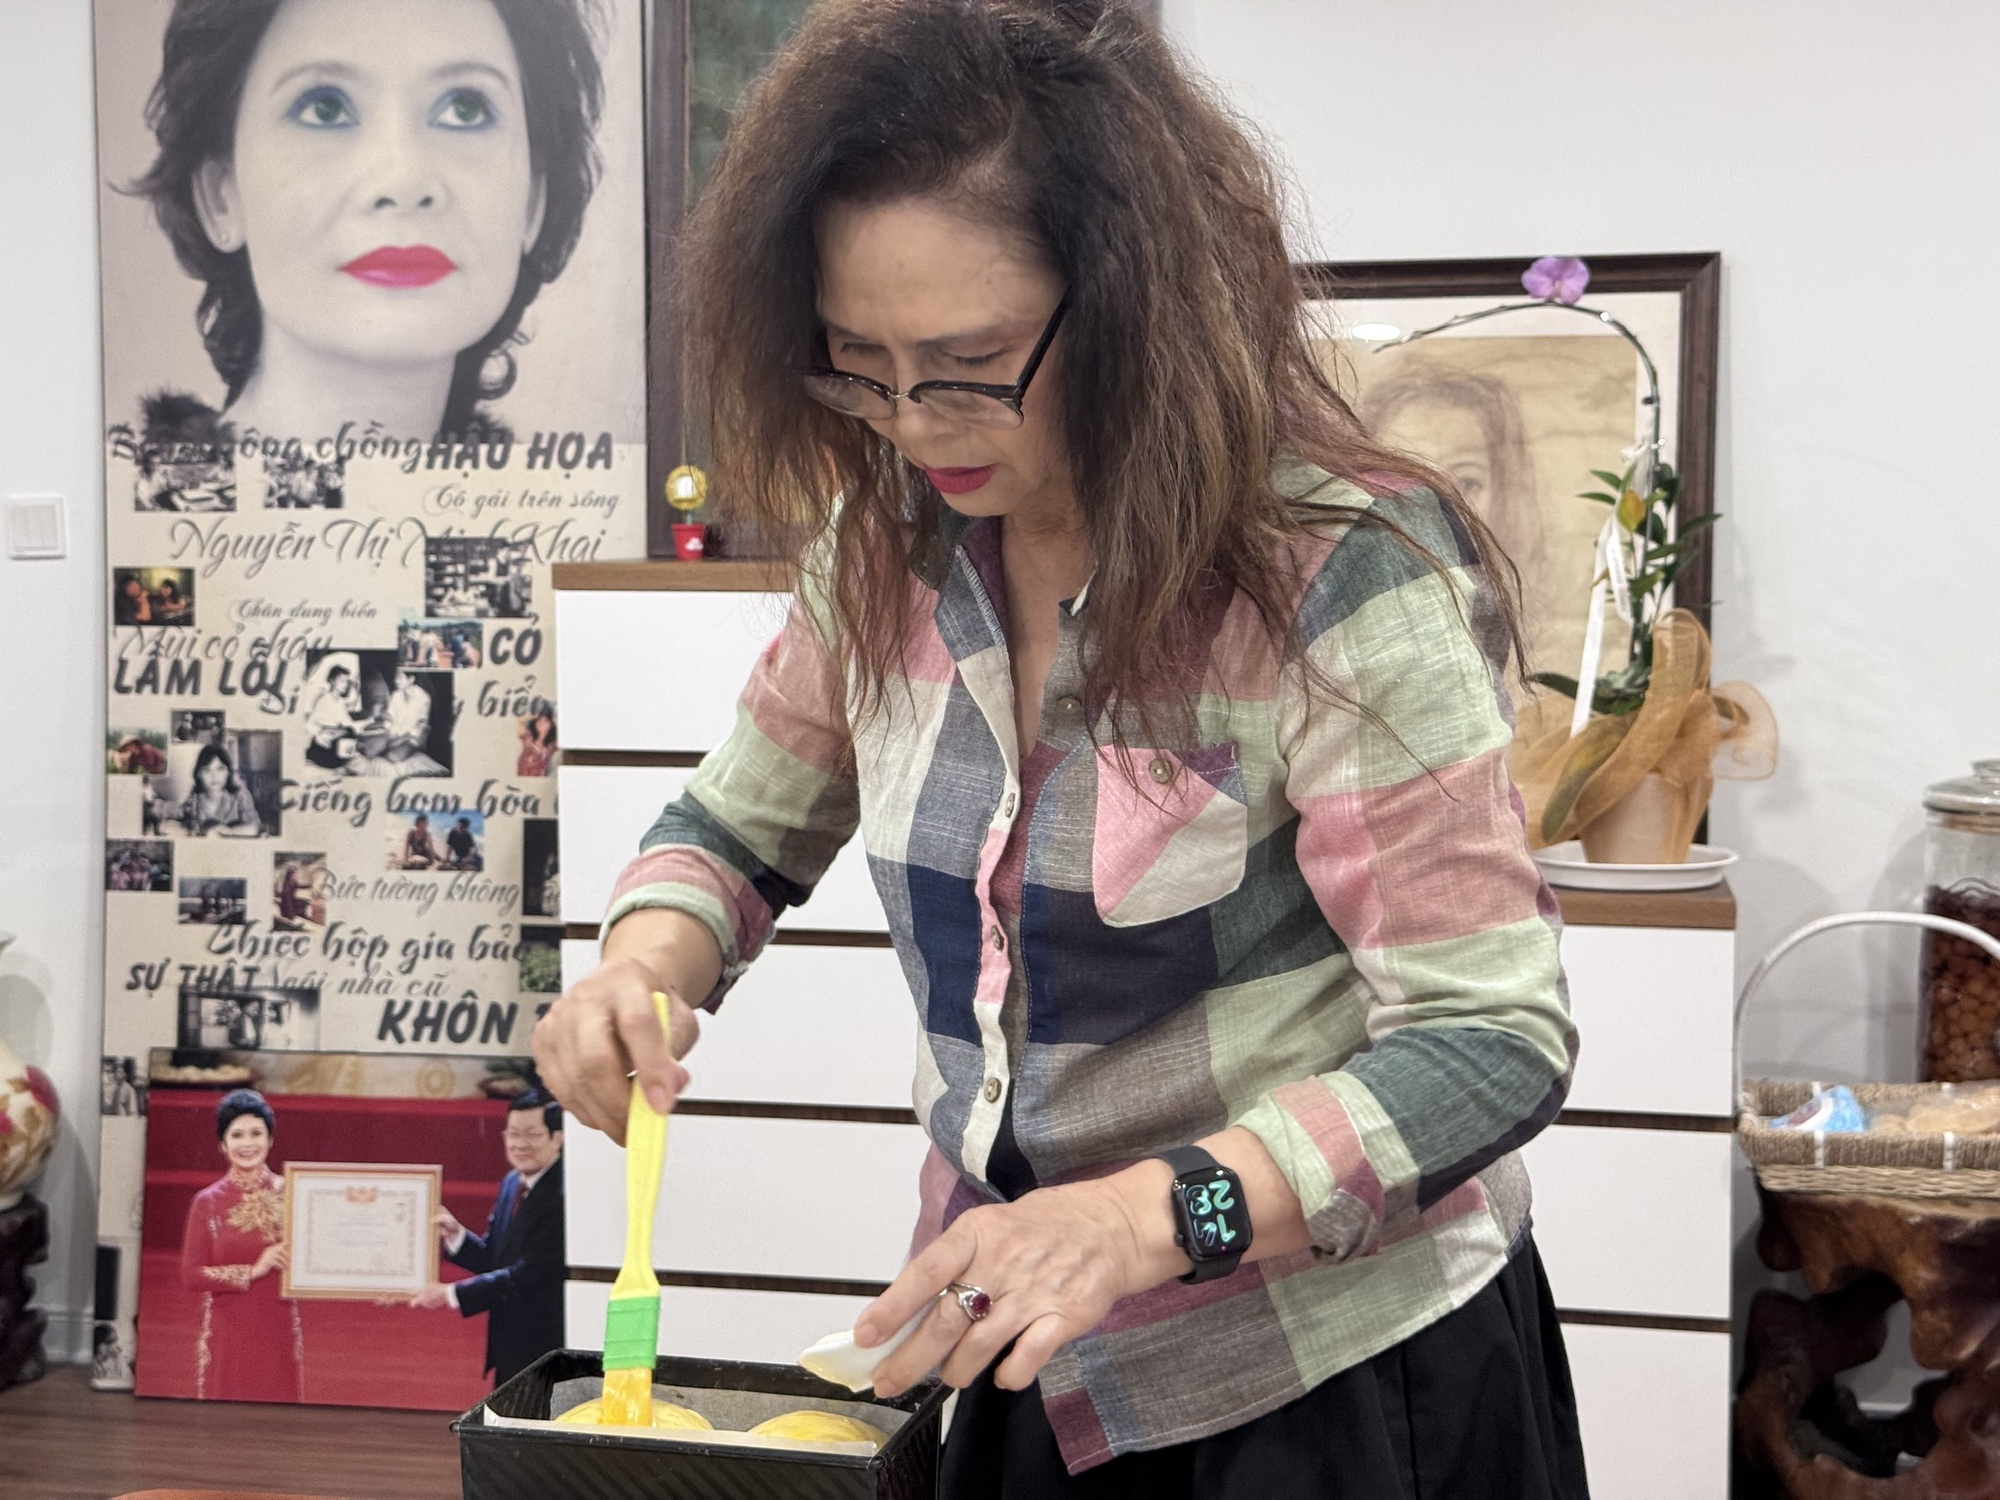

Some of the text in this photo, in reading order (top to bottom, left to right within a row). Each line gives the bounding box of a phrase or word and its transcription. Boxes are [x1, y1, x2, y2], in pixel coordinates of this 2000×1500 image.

[425, 421, 612, 479] HẬU HỌA
[474, 489, 508, 519] gái
[519, 490, 562, 508] trên
[569, 490, 619, 519] sông
[170, 516, 316, 579] Nguyễn
[321, 516, 396, 568] Thị
[490, 612, 543, 665] CỎ
[446, 871, 520, 916] không
[400, 931, 454, 974] gia
[126, 957, 171, 998] SỰ
[377, 990, 519, 1044] KHÔN
